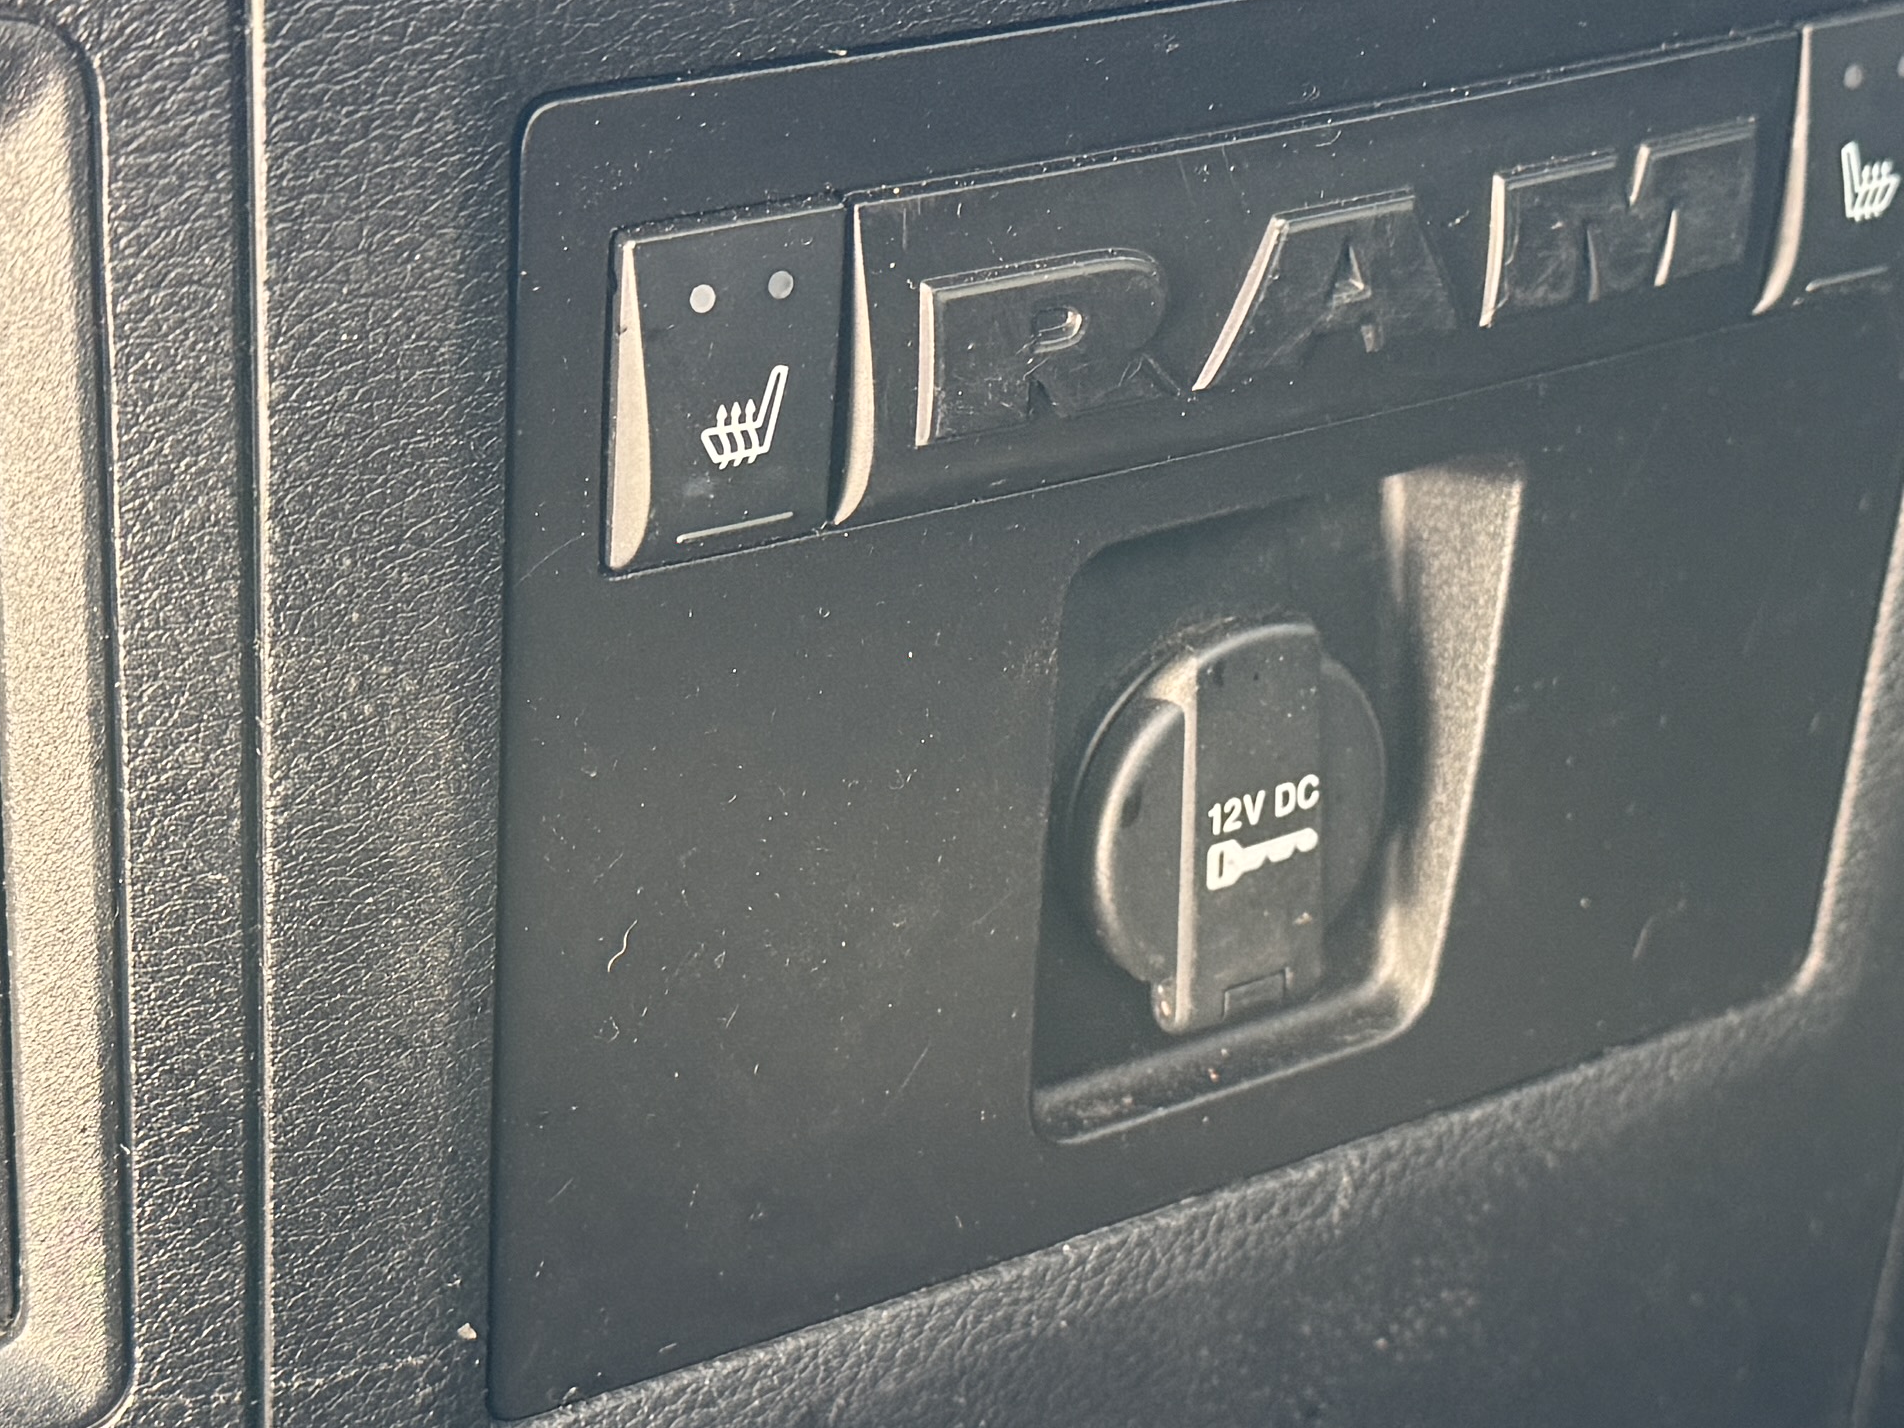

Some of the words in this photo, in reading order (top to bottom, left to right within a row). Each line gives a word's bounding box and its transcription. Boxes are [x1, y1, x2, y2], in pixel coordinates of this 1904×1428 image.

[915, 115, 1757, 448] RAM
[1207, 789, 1266, 836] 12V
[1274, 773, 1320, 818] DC
